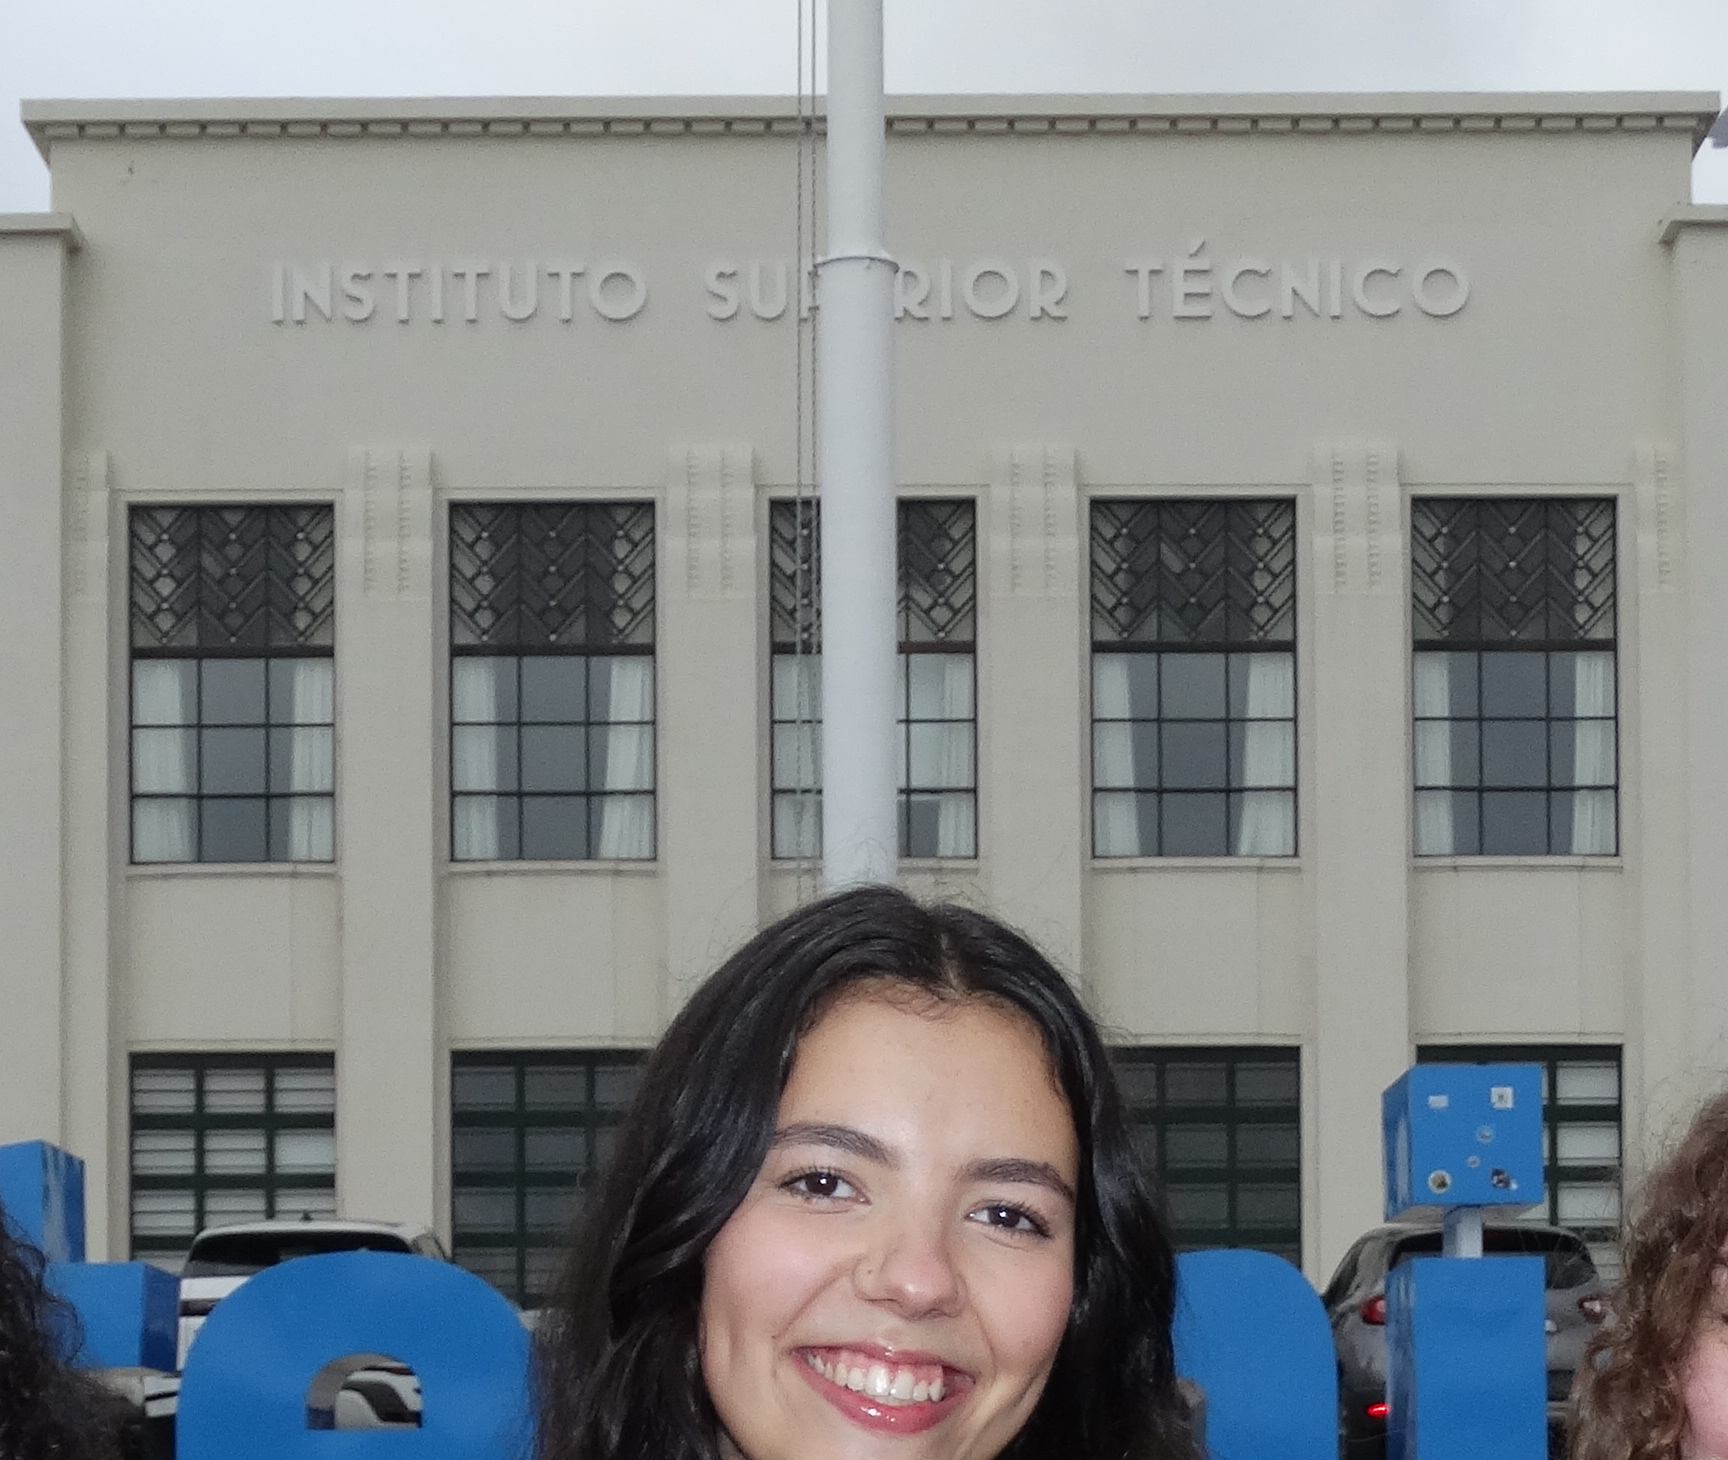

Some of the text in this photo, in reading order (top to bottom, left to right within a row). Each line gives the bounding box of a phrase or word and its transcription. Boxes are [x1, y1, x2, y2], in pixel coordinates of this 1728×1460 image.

[271, 238, 1471, 325] INSTITUTO SURIOR TÉCNICO
